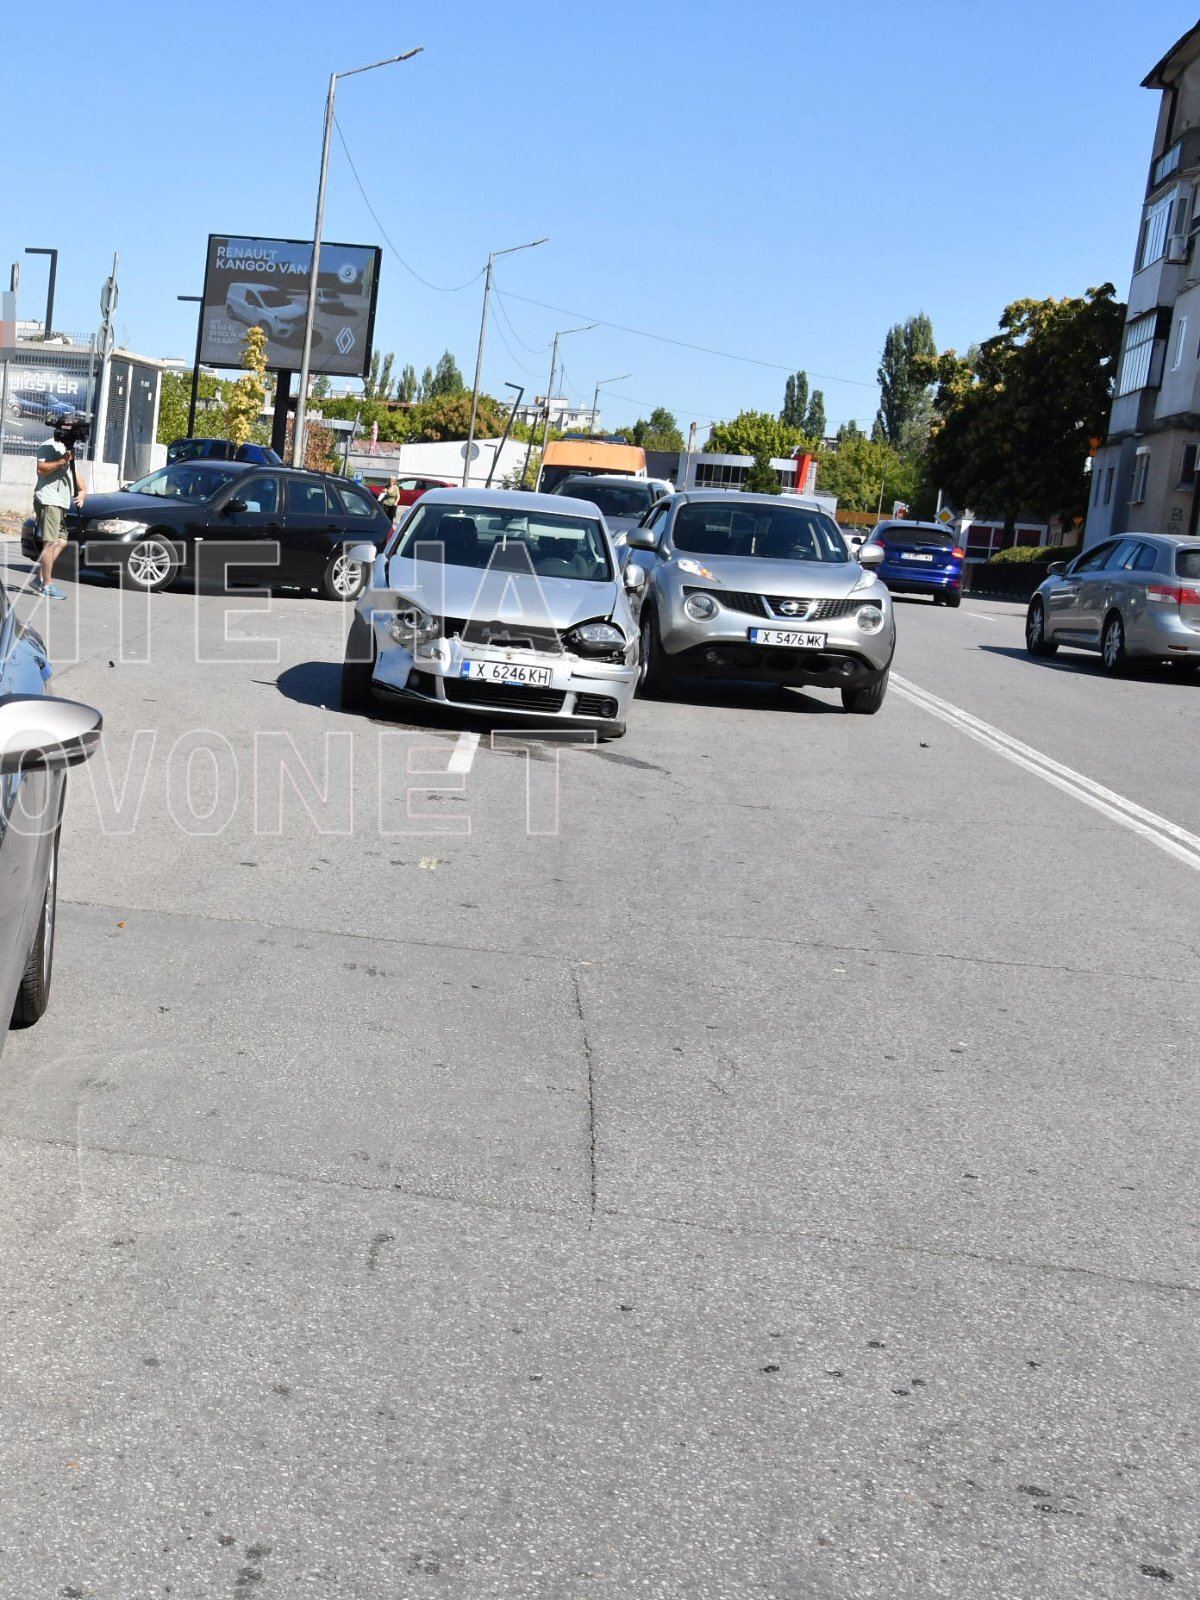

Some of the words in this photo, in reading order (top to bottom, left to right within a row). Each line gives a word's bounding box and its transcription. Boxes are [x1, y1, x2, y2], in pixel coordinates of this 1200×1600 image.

[216, 246, 278, 260] RENAULT
[216, 258, 276, 272] KANGOO
[279, 263, 308, 275] VAN
[776, 632, 804, 646] 5476
[806, 635, 822, 647] MK
[492, 665, 526, 681] 6246
[529, 669, 548, 685] KH
